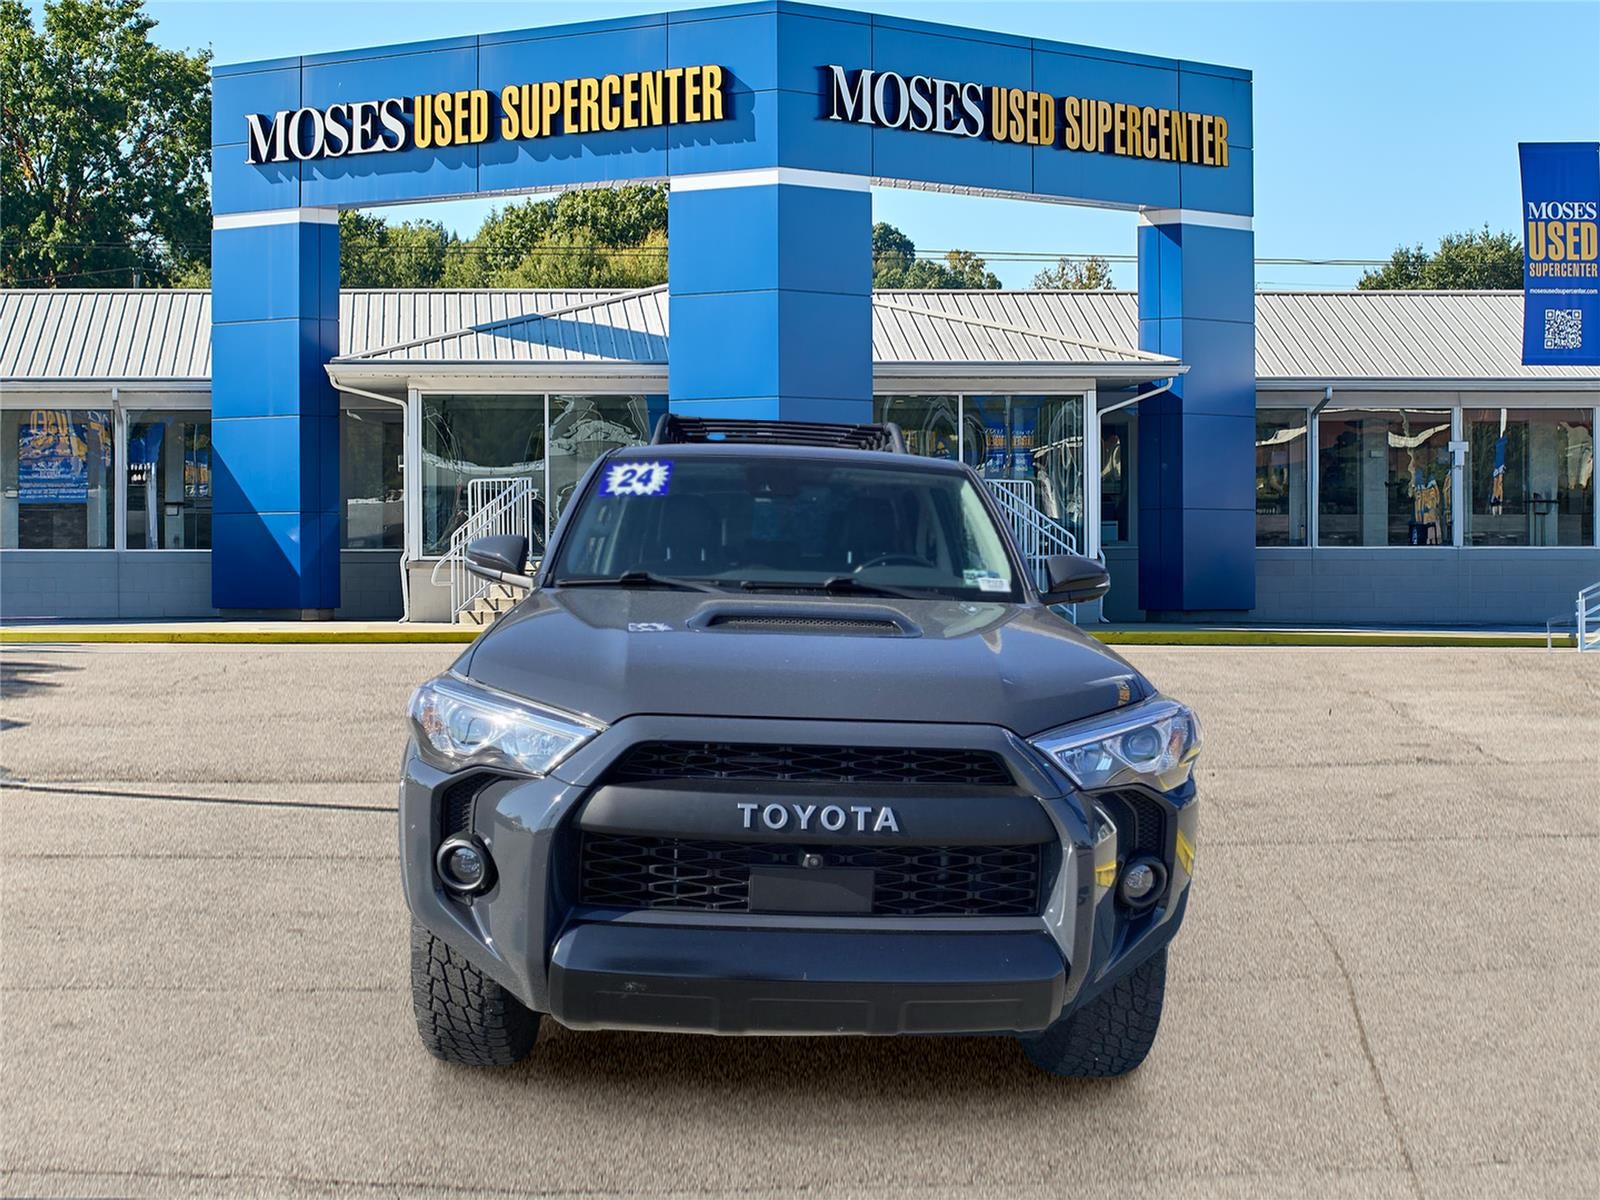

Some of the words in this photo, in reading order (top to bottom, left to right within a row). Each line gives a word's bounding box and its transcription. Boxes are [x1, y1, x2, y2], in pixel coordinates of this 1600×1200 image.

[245, 98, 406, 165] MOSES
[413, 89, 489, 150] USED
[501, 63, 724, 141] SUPERCENTER
[828, 64, 985, 138] MOSES
[991, 86, 1055, 146] USED
[1065, 95, 1230, 167] SUPERCENTER
[1527, 201, 1598, 221] MOSES
[1528, 221, 1598, 261] USED
[1529, 263, 1598, 278] SUPERCENTER
[617, 468, 655, 487] 24
[737, 802, 900, 832] TOYOTA
